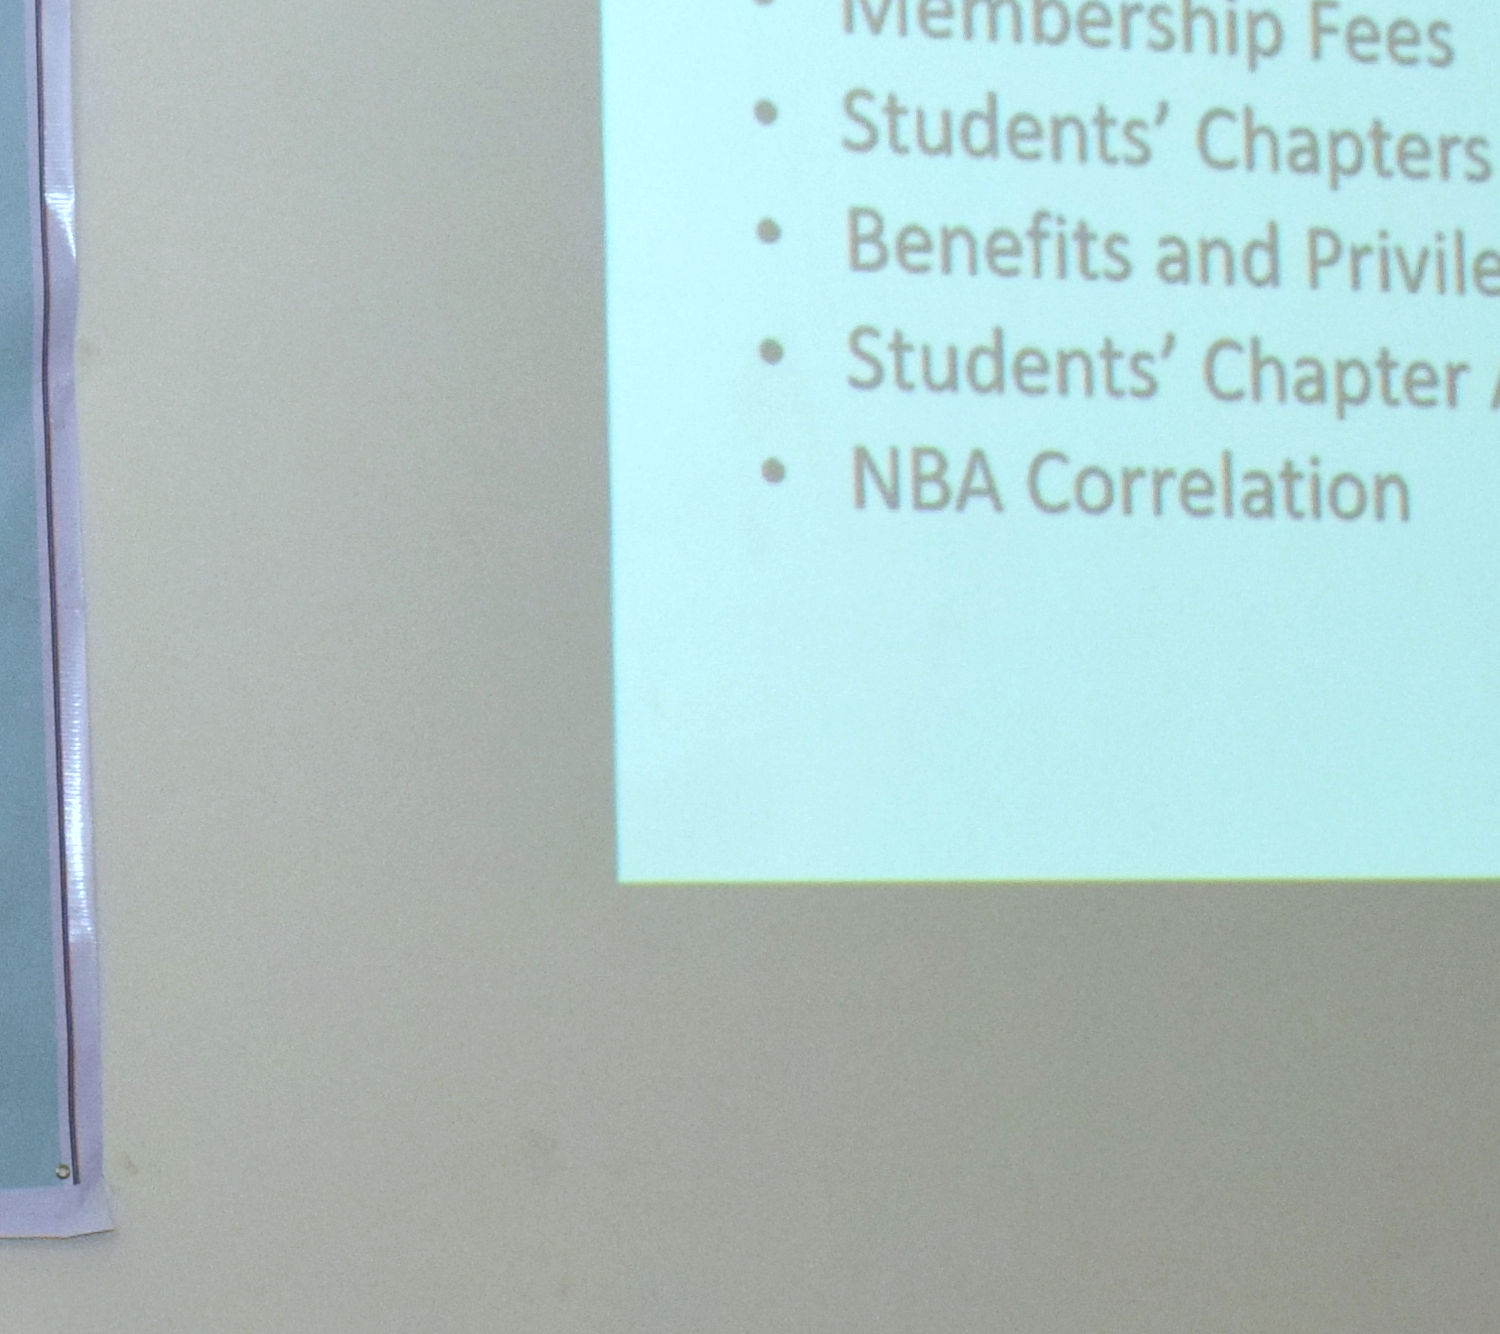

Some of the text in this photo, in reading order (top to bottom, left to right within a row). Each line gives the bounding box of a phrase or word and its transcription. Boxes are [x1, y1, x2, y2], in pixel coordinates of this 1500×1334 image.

[840, 88, 1170, 169] Students’
[1195, 105, 1493, 194] Chapters
[845, 207, 1134, 288] Benefits
[1155, 221, 1281, 291] and
[846, 325, 1177, 403] Students’
[1202, 337, 1468, 419] Chapter
[850, 444, 1411, 524] NBA Correlation
